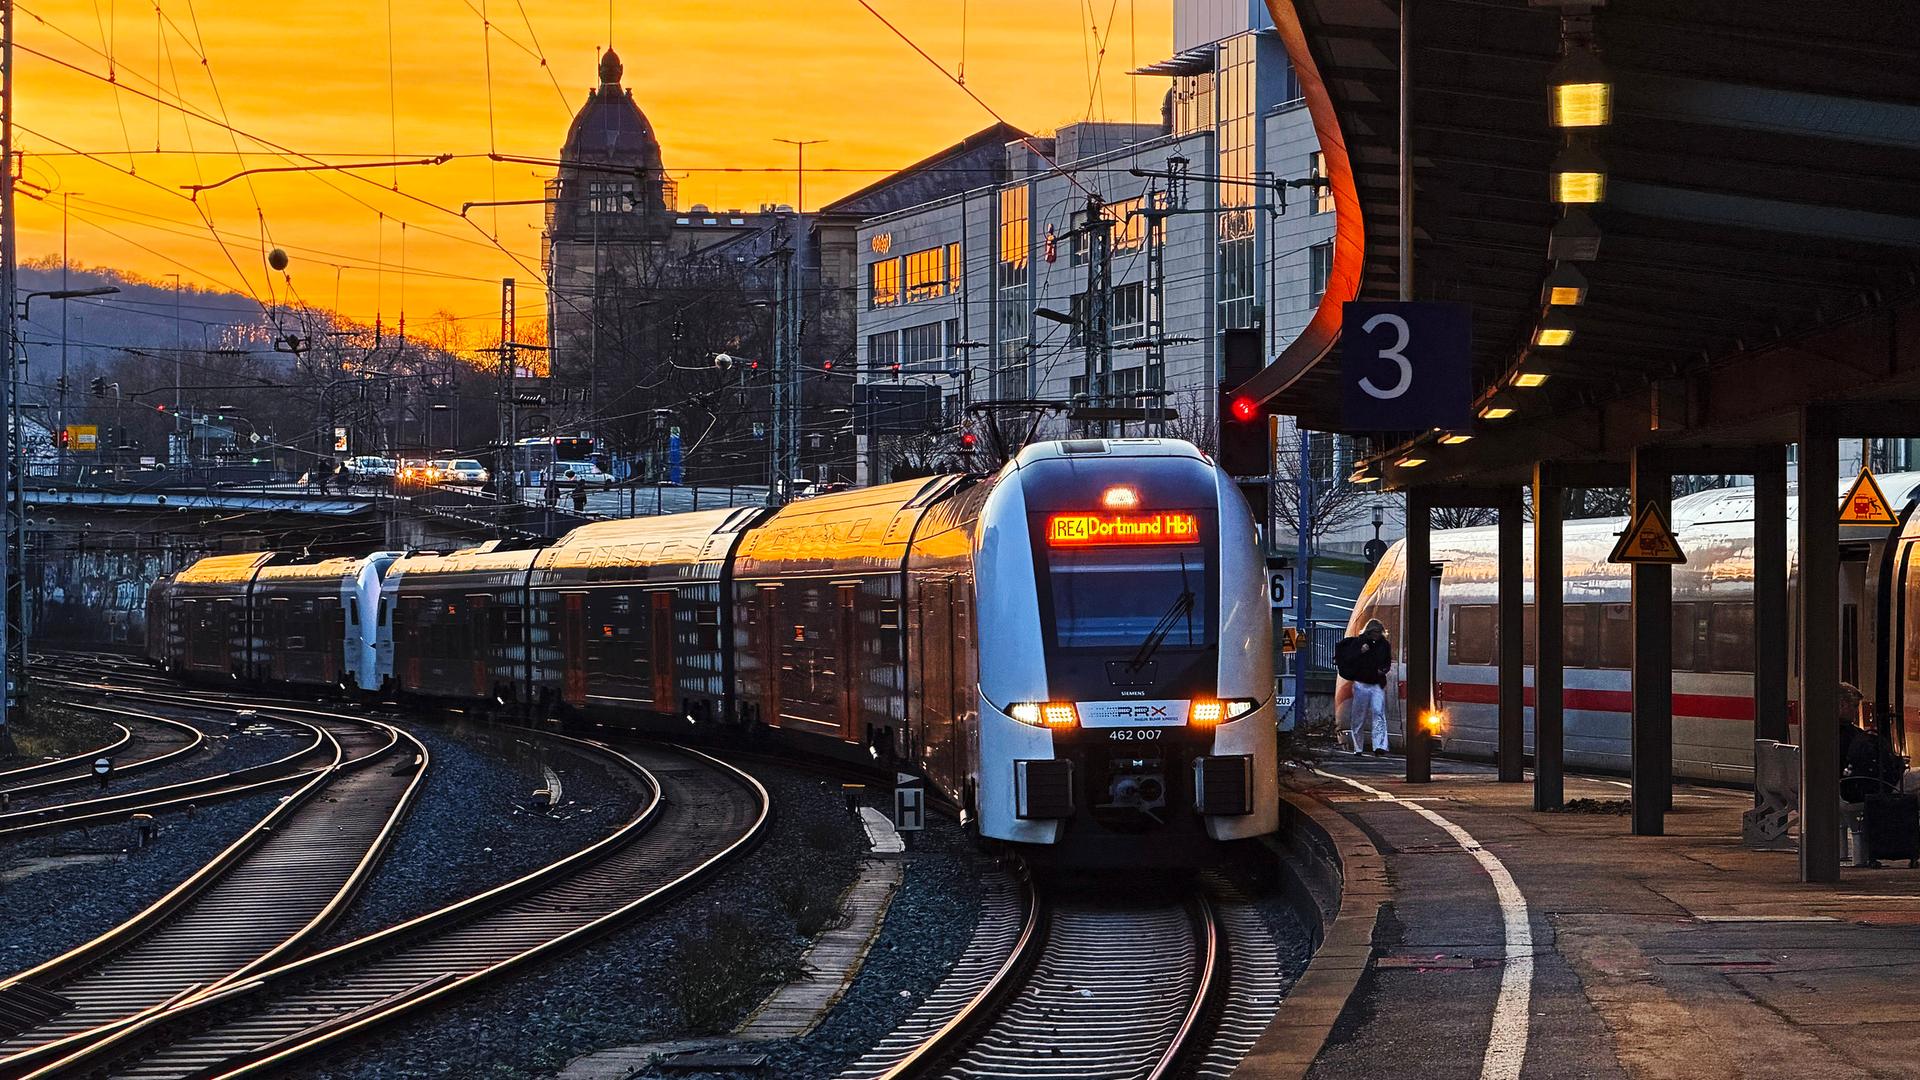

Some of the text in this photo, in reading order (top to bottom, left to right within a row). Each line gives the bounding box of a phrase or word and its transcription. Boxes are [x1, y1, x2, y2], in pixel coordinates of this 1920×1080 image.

[1358, 313, 1412, 399] 3
[1057, 520, 1084, 536] RE4
[1089, 516, 1161, 535] Dortmund
[1271, 574, 1284, 602] 6
[1117, 706, 1167, 717] RRX
[1109, 729, 1162, 740] 462 007
[898, 792, 920, 826] H
